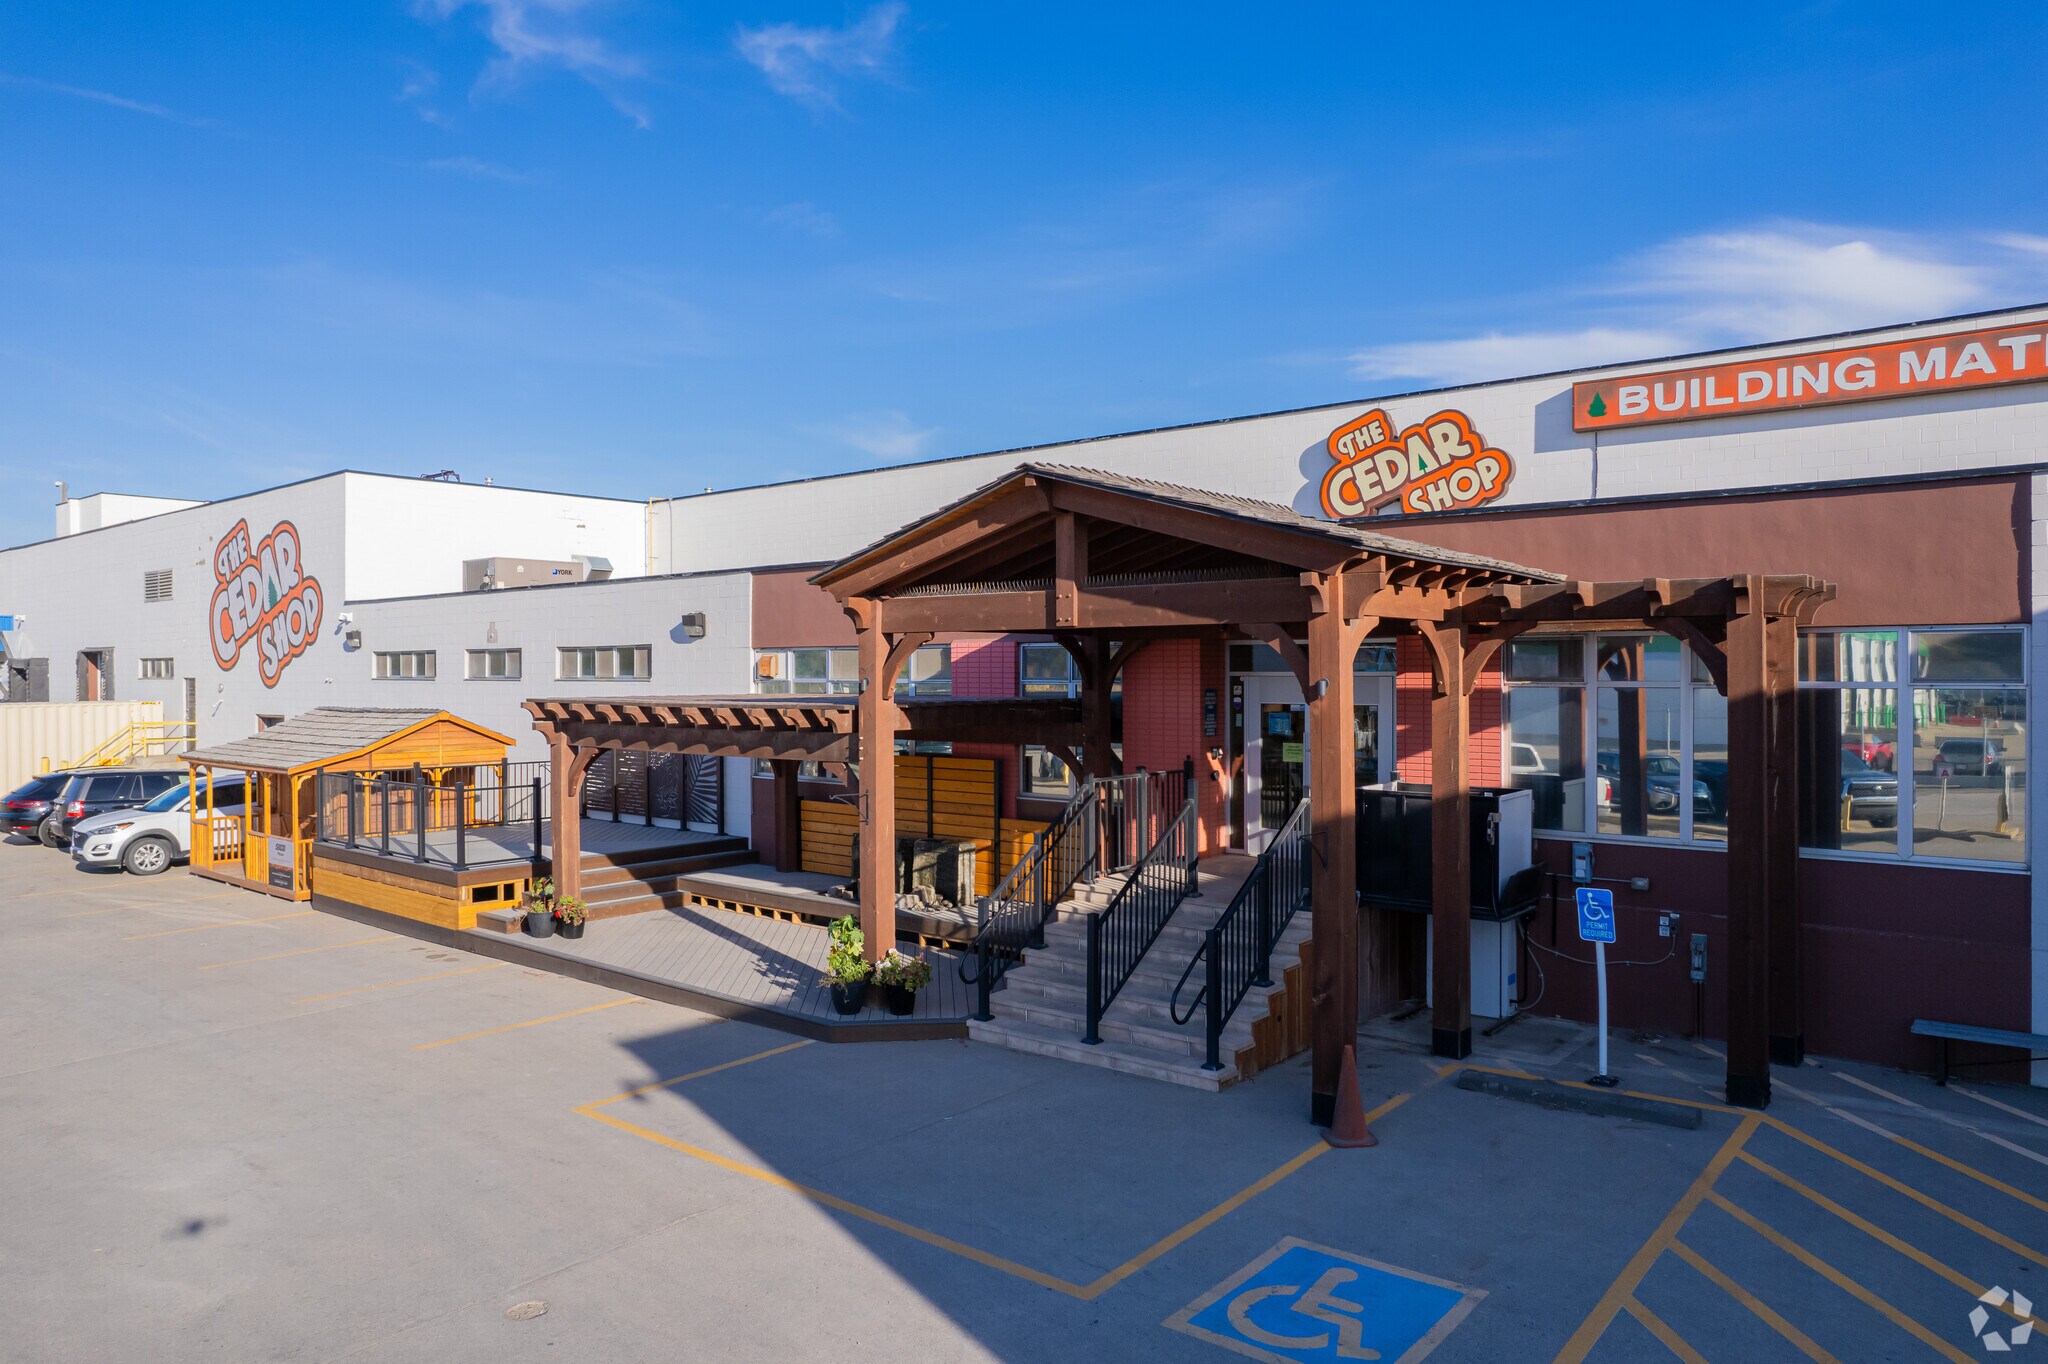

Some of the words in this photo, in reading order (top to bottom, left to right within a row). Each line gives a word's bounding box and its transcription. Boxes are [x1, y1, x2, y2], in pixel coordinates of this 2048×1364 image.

[1618, 357, 1876, 416] BUILDING
[1899, 333, 2048, 384] MAT
[1337, 420, 1385, 459] THE
[1329, 421, 1471, 516] CEDAR
[1409, 457, 1500, 512] SHOP
[217, 528, 248, 582] THE
[213, 532, 299, 661] CEDAR
[260, 587, 319, 678] SHOP
[1582, 928, 1613, 939] REQUIRED
[1585, 921, 1608, 930] PERMIT
